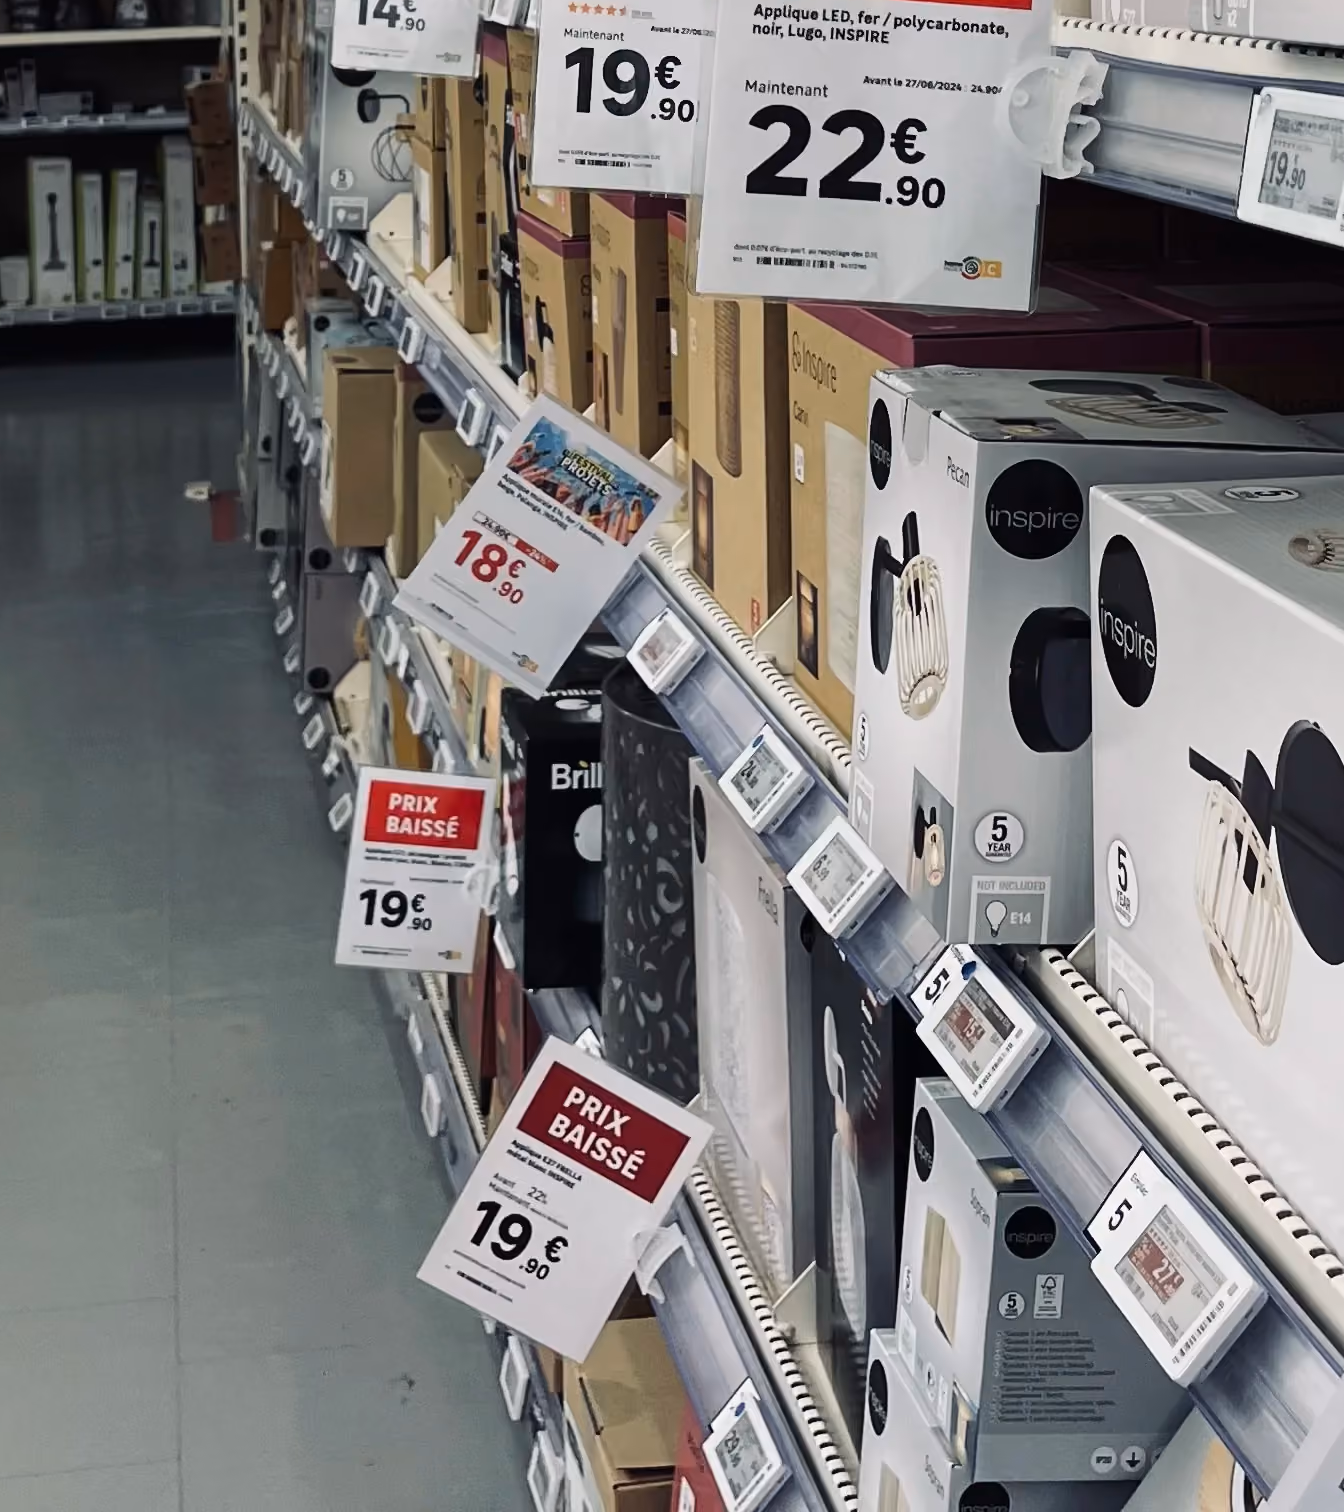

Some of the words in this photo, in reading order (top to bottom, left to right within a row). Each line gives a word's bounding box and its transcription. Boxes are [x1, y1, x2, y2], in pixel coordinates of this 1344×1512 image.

[564, 28, 624, 42] Maintenant
[753, 22, 784, 38] noir,
[788, 25, 826, 42] Lugo,
[830, 27, 889, 44] INSPIRE
[754, 4, 819, 24] Applique
[822, 9, 854, 25] LED,
[858, 10, 880, 26] fer
[893, 16, 1010, 39] polycarbonate,
[745, 80, 829, 98] Maintenant
[863, 76, 892, 87] Avant
[894, 77, 903, 87] le
[802, 338, 838, 394] Inspire
[560, 456, 614, 498] PROJETS
[571, 453, 615, 484] FESTIVAL
[946, 455, 970, 488] Pecan
[990, 504, 1080, 533] inspire
[1100, 598, 1157, 669] inspire
[551, 760, 603, 790] Brill
[388, 793, 440, 814] PRIX
[386, 815, 460, 839] BAISSÉ
[991, 815, 1008, 842] 5
[987, 842, 1011, 852] YEAR
[1117, 845, 1127, 893] 5
[1010, 912, 1032, 925] E14
[924, 967, 951, 1001] 5
[563, 1086, 631, 1137] PRIX
[548, 1113, 647, 1180] BAISSÉ
[1108, 1197, 1133, 1231] 5
[1006, 1231, 1055, 1246] inspire
[1007, 1294, 1017, 1308] 5
